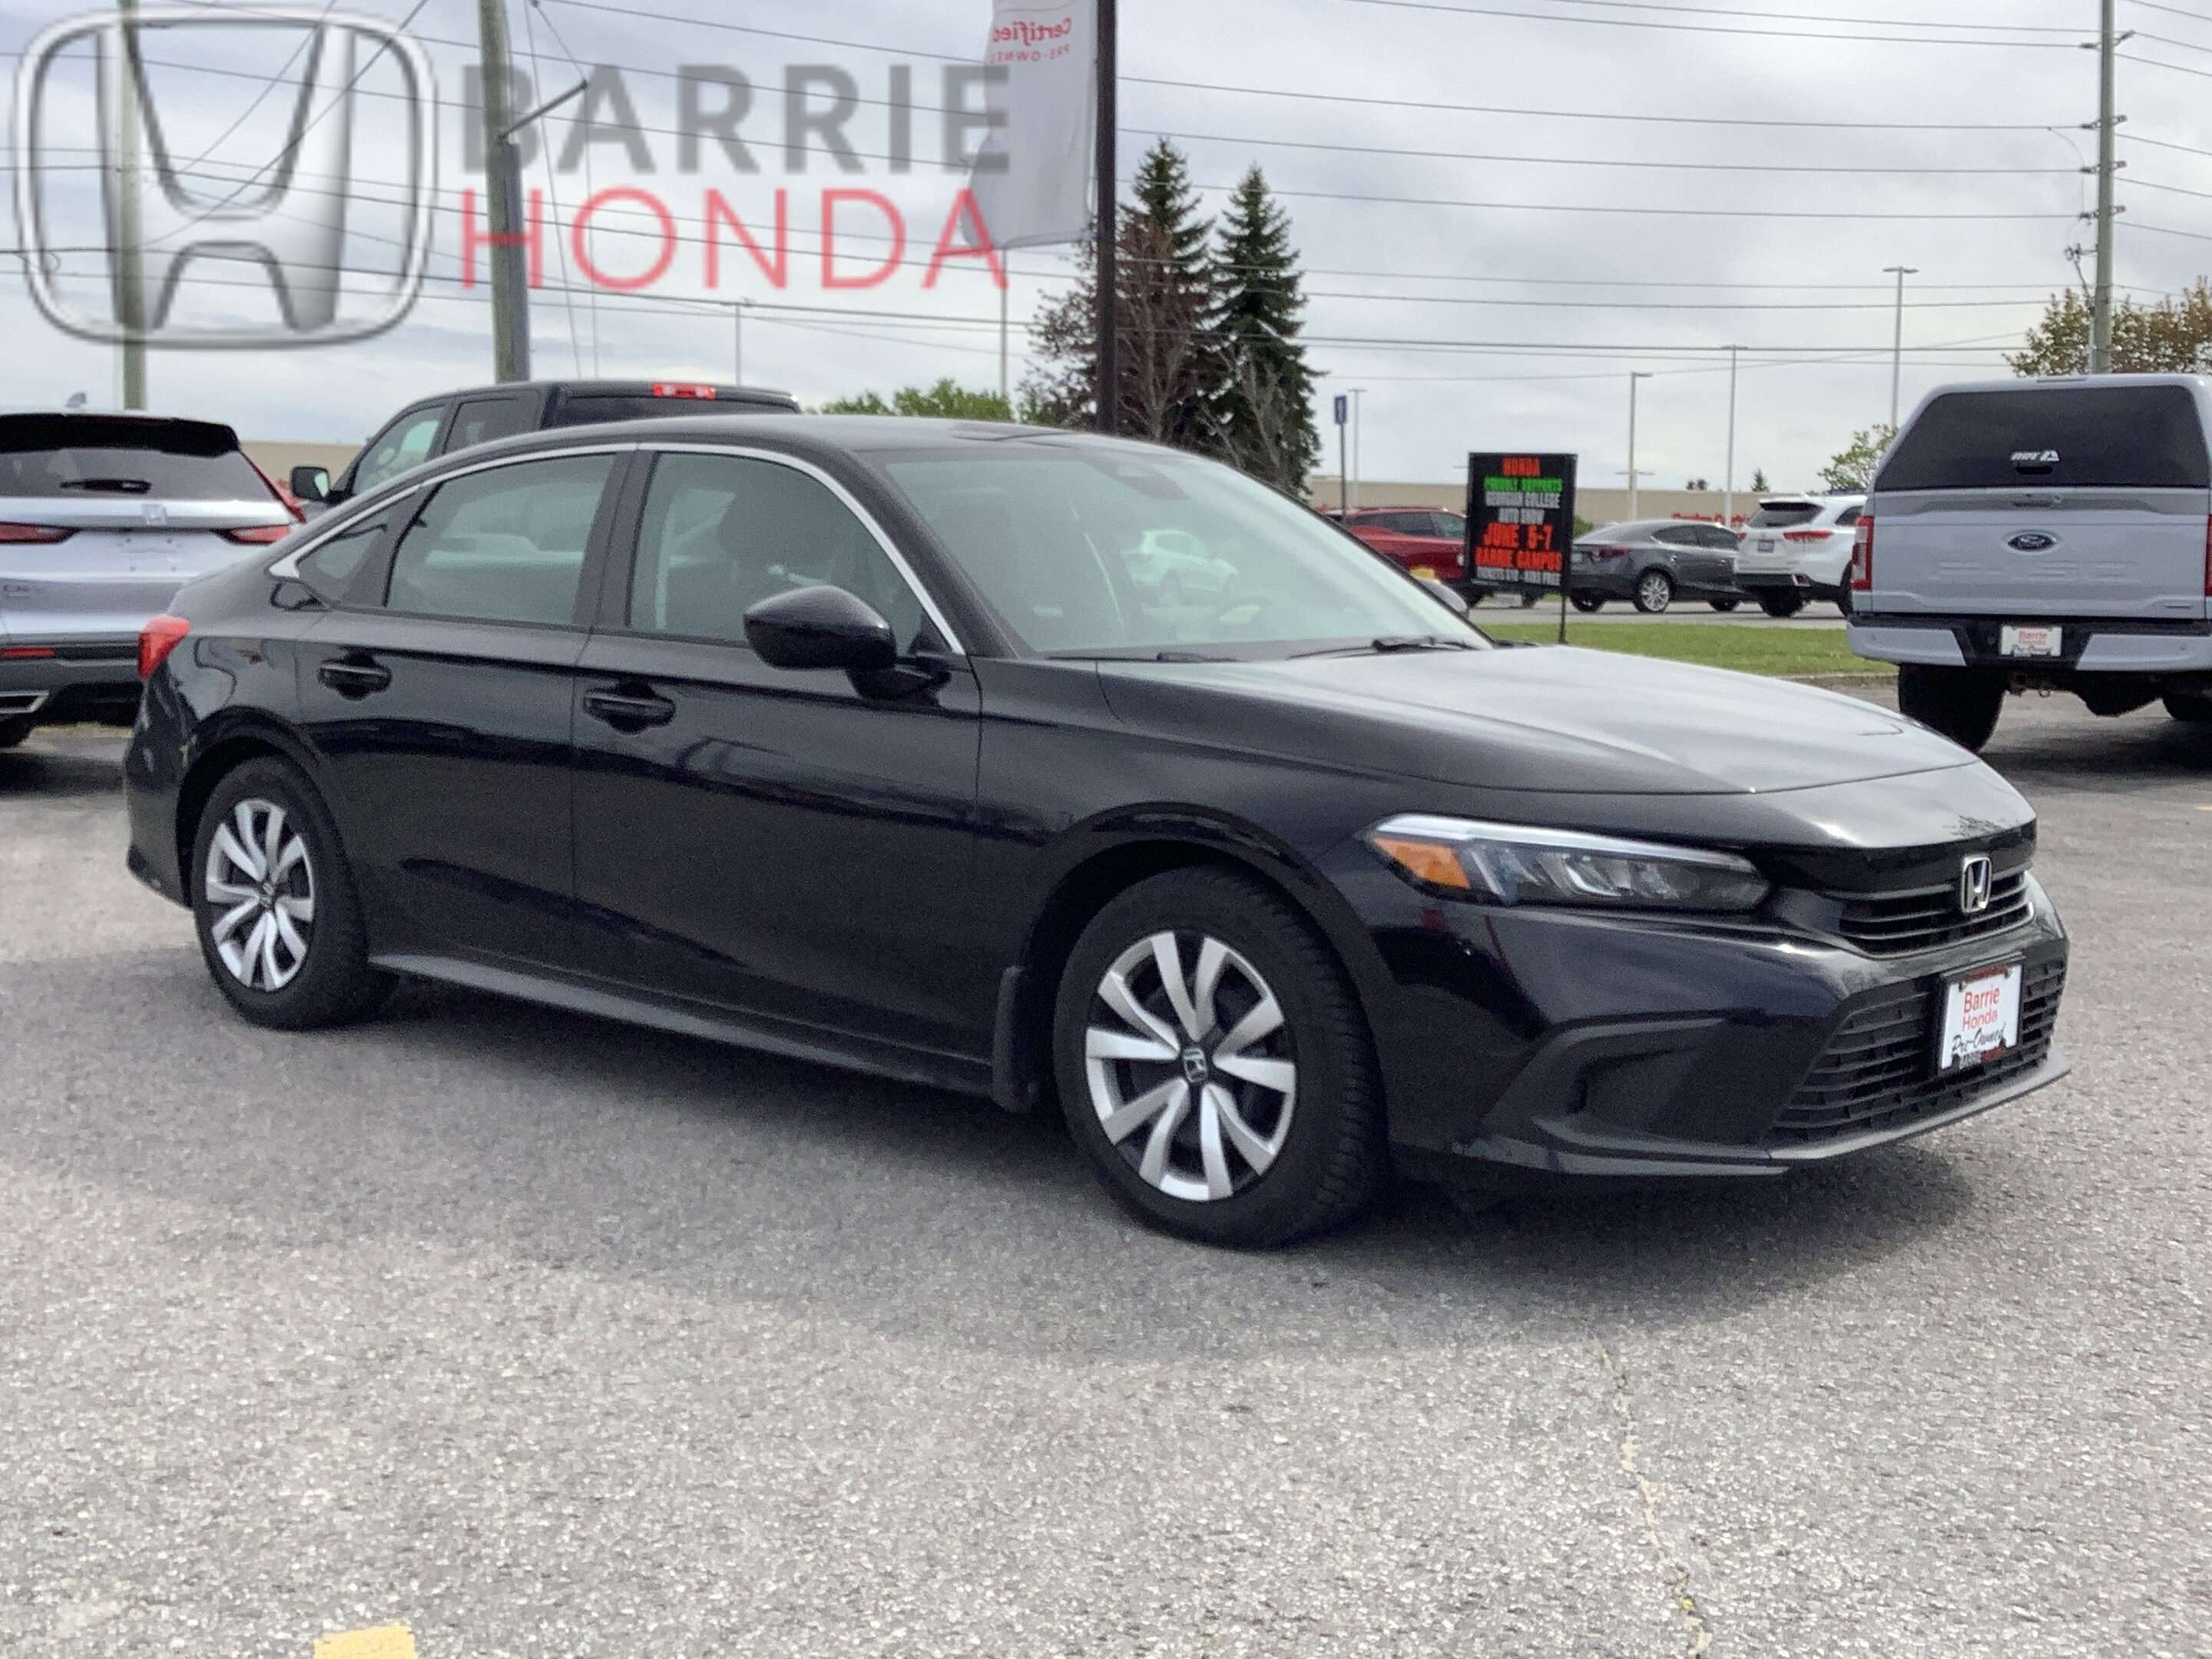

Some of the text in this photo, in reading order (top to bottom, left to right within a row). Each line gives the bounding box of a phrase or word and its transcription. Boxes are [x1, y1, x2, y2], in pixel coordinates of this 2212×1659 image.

[1524, 492, 1560, 509] COLLEGE
[1484, 522, 1519, 548] JUNE
[1517, 550, 1562, 571] CAMPUS
[1963, 986, 2000, 1014] Barrie
[1962, 1009, 1998, 1031] Honda
